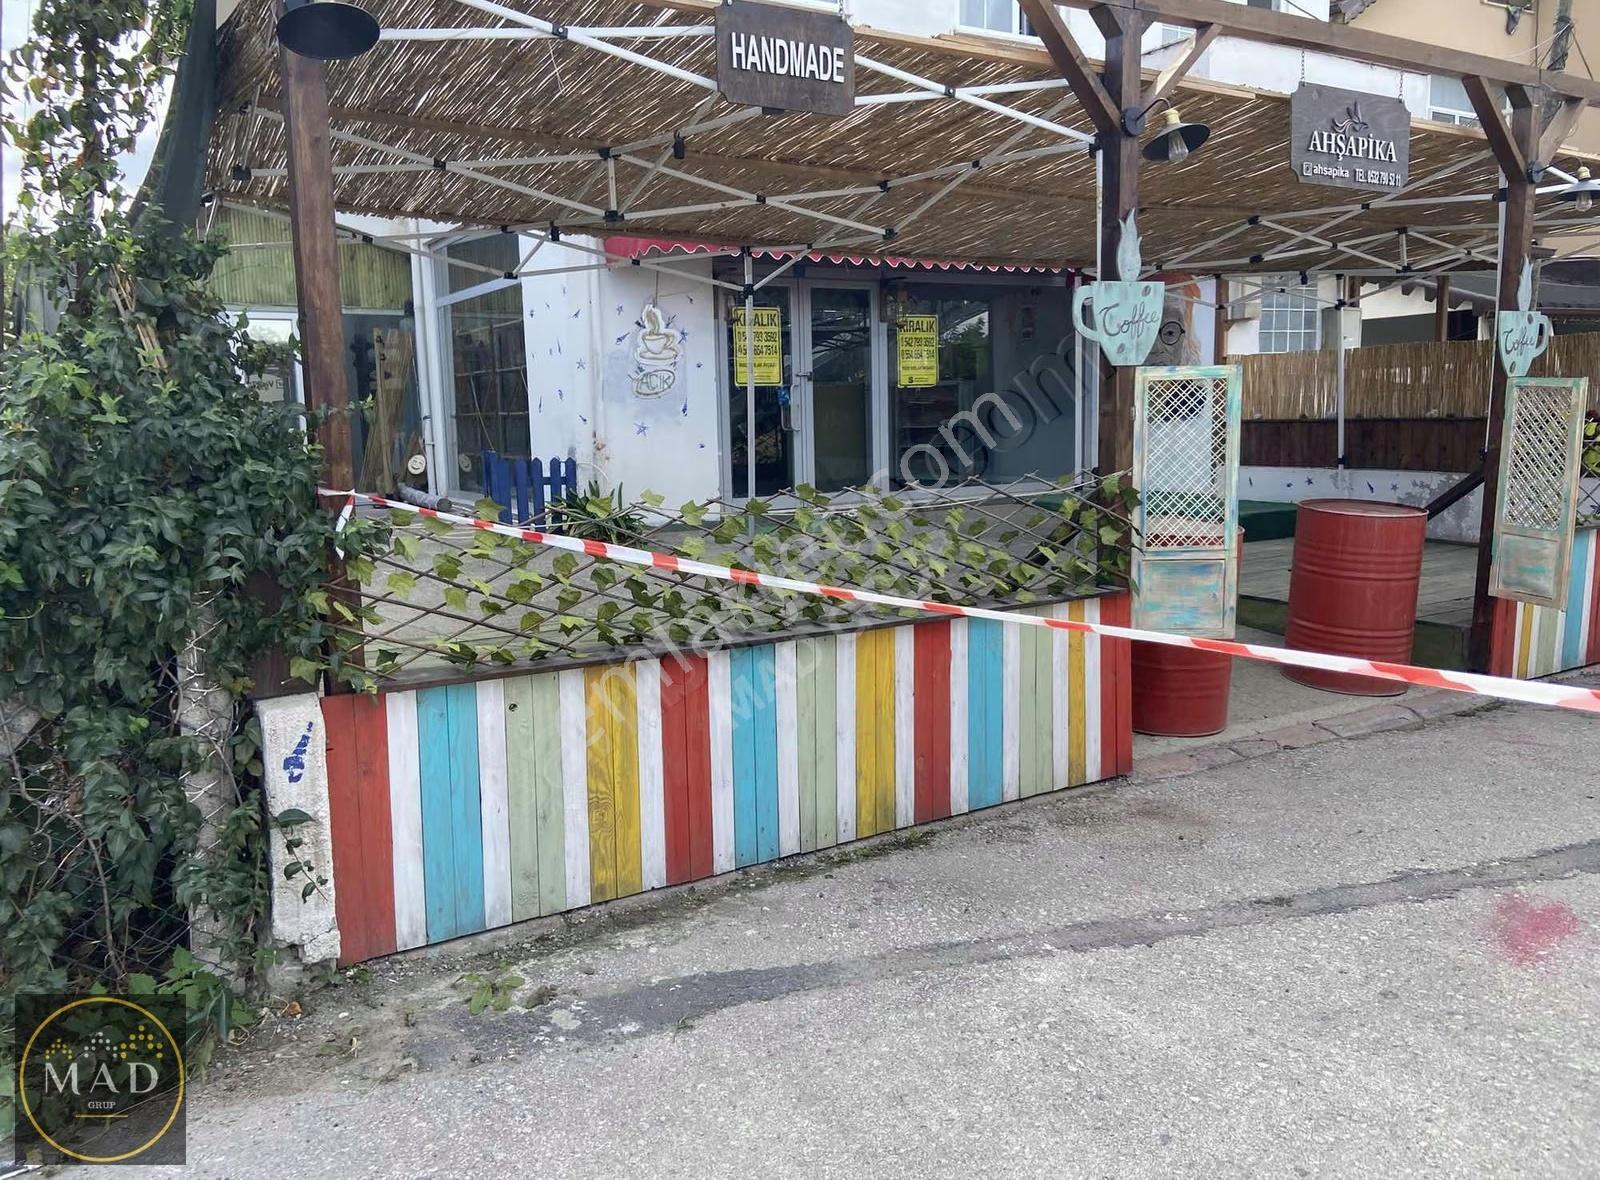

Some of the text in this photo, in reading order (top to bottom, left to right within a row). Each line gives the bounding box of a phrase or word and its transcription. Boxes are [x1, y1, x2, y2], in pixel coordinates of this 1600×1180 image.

[731, 31, 845, 84] HANDMADE
[1308, 130, 1398, 162] AHŞAPİKA
[1313, 163, 1350, 179] ahsapika
[736, 312, 777, 327] KIALIK
[1098, 301, 1160, 339] Coffee
[1503, 326, 1536, 356] Coffee
